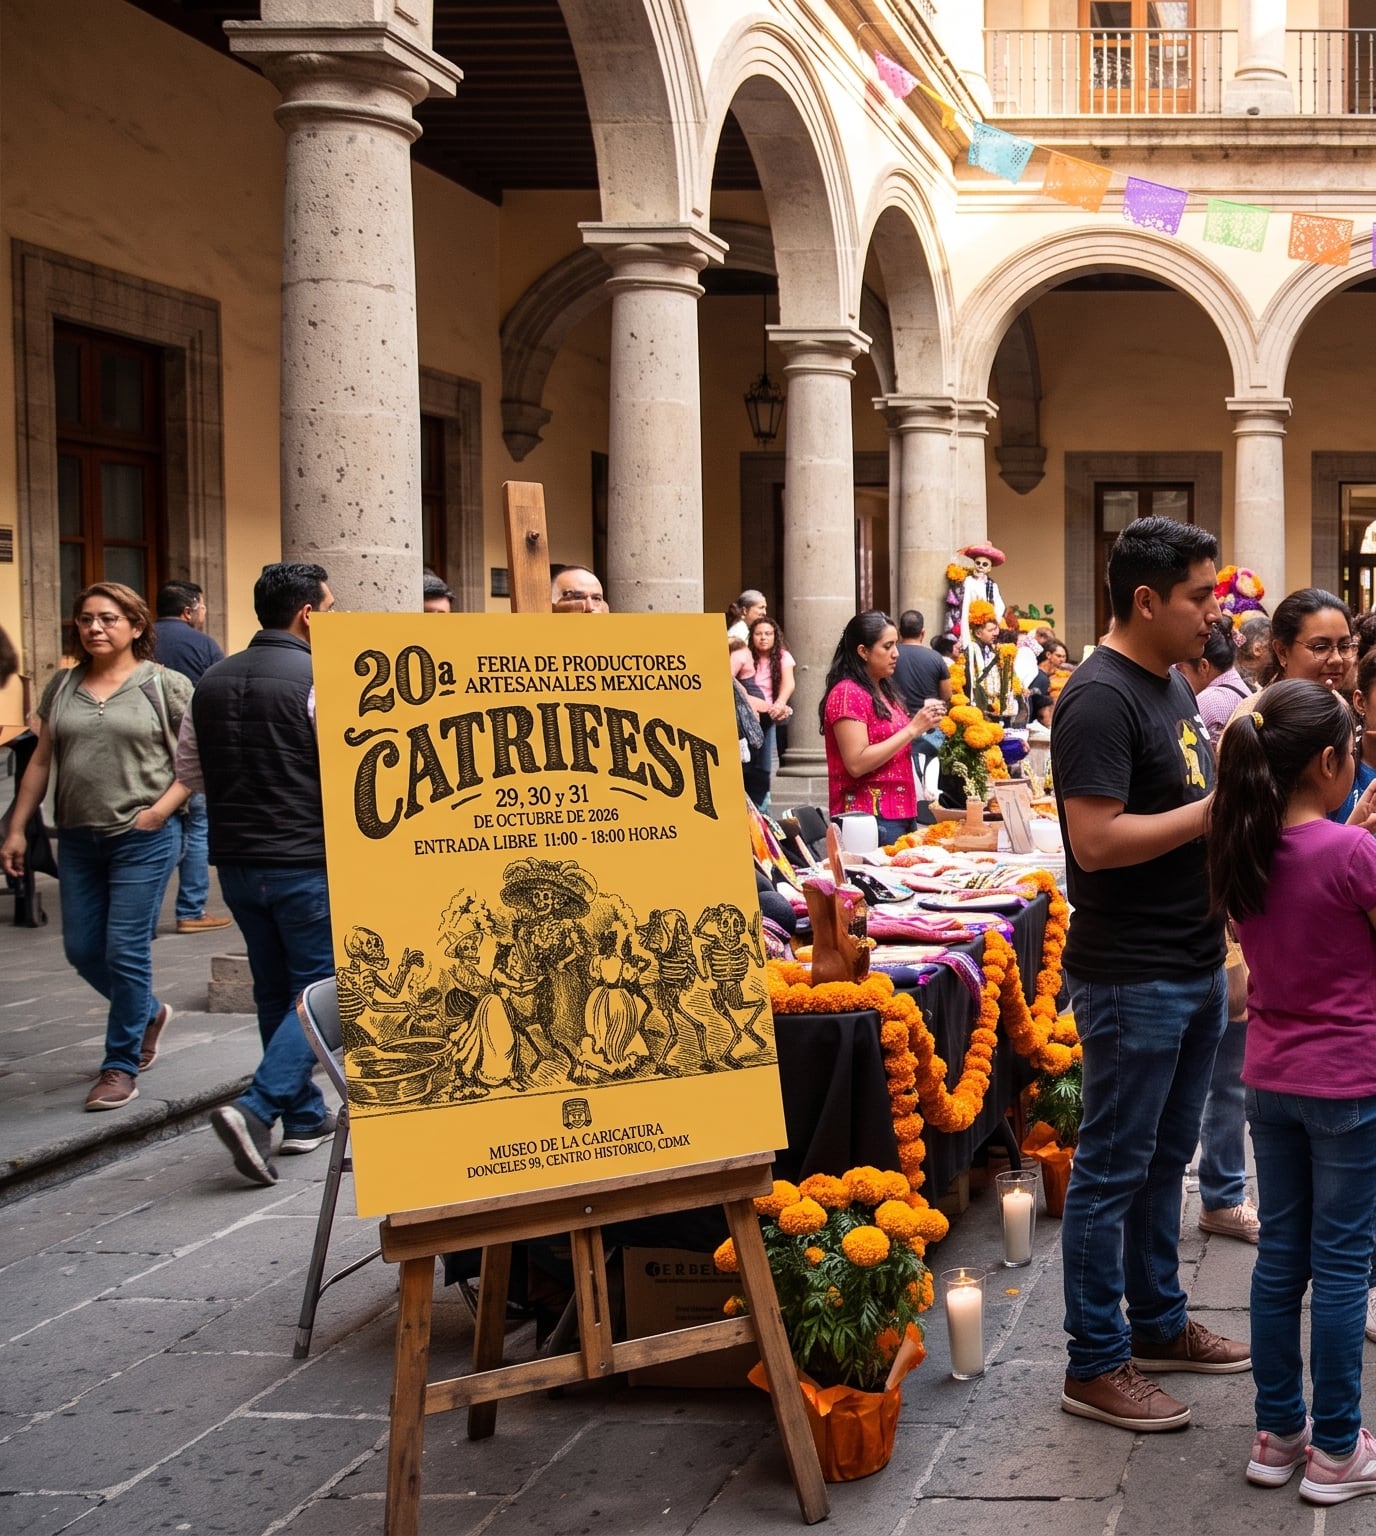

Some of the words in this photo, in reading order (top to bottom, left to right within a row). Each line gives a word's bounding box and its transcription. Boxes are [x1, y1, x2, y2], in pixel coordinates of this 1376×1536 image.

[477, 655, 532, 673] FERIA
[535, 655, 559, 673] DE
[563, 655, 687, 672] PRODUCTORES
[465, 675, 597, 694] ARTESANALES
[601, 674, 702, 692] MEXICANOS
[353, 703, 720, 840] CATRIFEST
[496, 788, 525, 810] 29,
[528, 786, 551, 806] 30
[555, 792, 566, 808] y
[569, 784, 590, 804] 31
[474, 814, 495, 829] DE
[497, 810, 562, 828] OCTUBRE
[566, 810, 586, 824] DE
[588, 808, 620, 823] 2026
[413, 837, 490, 856] ENTRADA
[493, 833, 538, 850] LIBRE
[544, 830, 578, 847] 11:00
[591, 829, 625, 845] 18:00
[628, 825, 678, 841] HORAS
[489, 1141, 538, 1160] MUSEO
[540, 1137, 562, 1153] DE
[561, 1135, 580, 1150] LA
[582, 1122, 665, 1146] CARICATURA
[466, 1157, 527, 1179] DONCELES
[528, 1156, 545, 1171] 99,
[546, 1147, 591, 1167] CENTRO
[657, 1134, 691, 1151] CDMX
